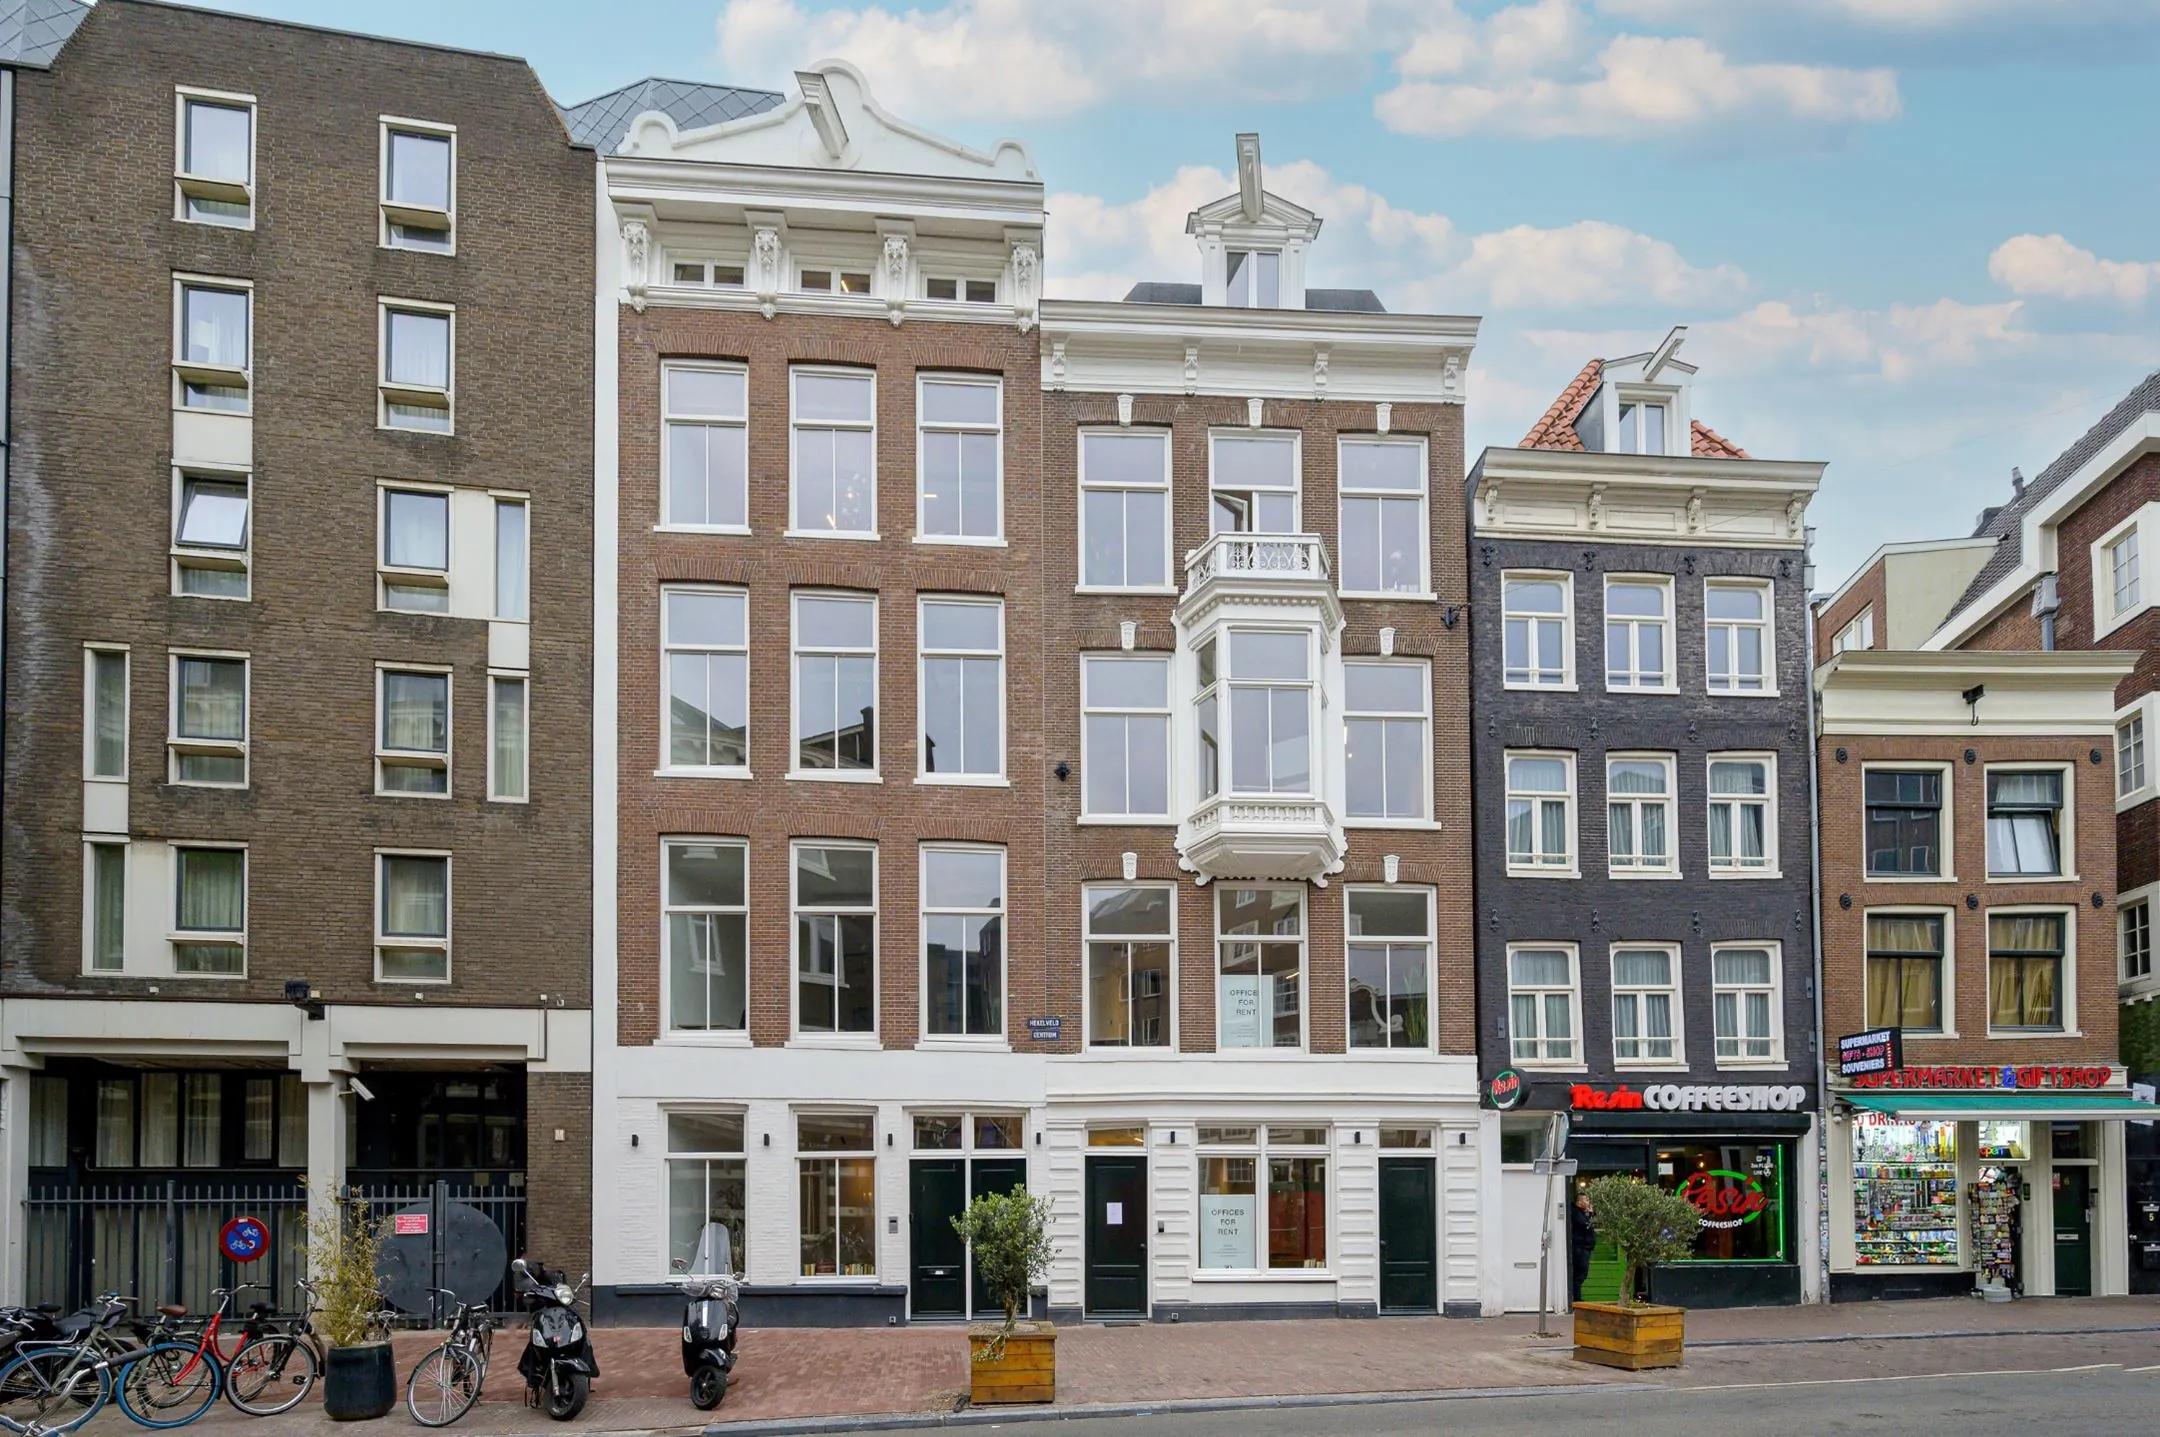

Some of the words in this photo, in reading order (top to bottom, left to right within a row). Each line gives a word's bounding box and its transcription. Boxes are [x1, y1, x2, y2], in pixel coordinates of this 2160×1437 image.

[1236, 1008, 1256, 1016] RENT
[1033, 1031, 1057, 1039] CENTRUM
[1840, 1031, 1891, 1049] SUPERMARKET
[1866, 1045, 1885, 1058] SHOP
[1842, 1058, 1885, 1074] SOUVENIERS
[2002, 1065, 2016, 1088] &
[2016, 1066, 2112, 1088] GIFTSHOP
[1570, 1084, 1642, 1109] Resin
[1643, 1084, 1806, 1111] COFFEESHOP
[1680, 1172, 1768, 1215] Resin
[1211, 1208, 1245, 1216] OFFICES
[2149, 1213, 2155, 1222] 5
[1220, 1218, 1236, 1226] FOR
[1698, 1218, 1743, 1229] COFFEESHOP
[1217, 1228, 1238, 1236] RENT
